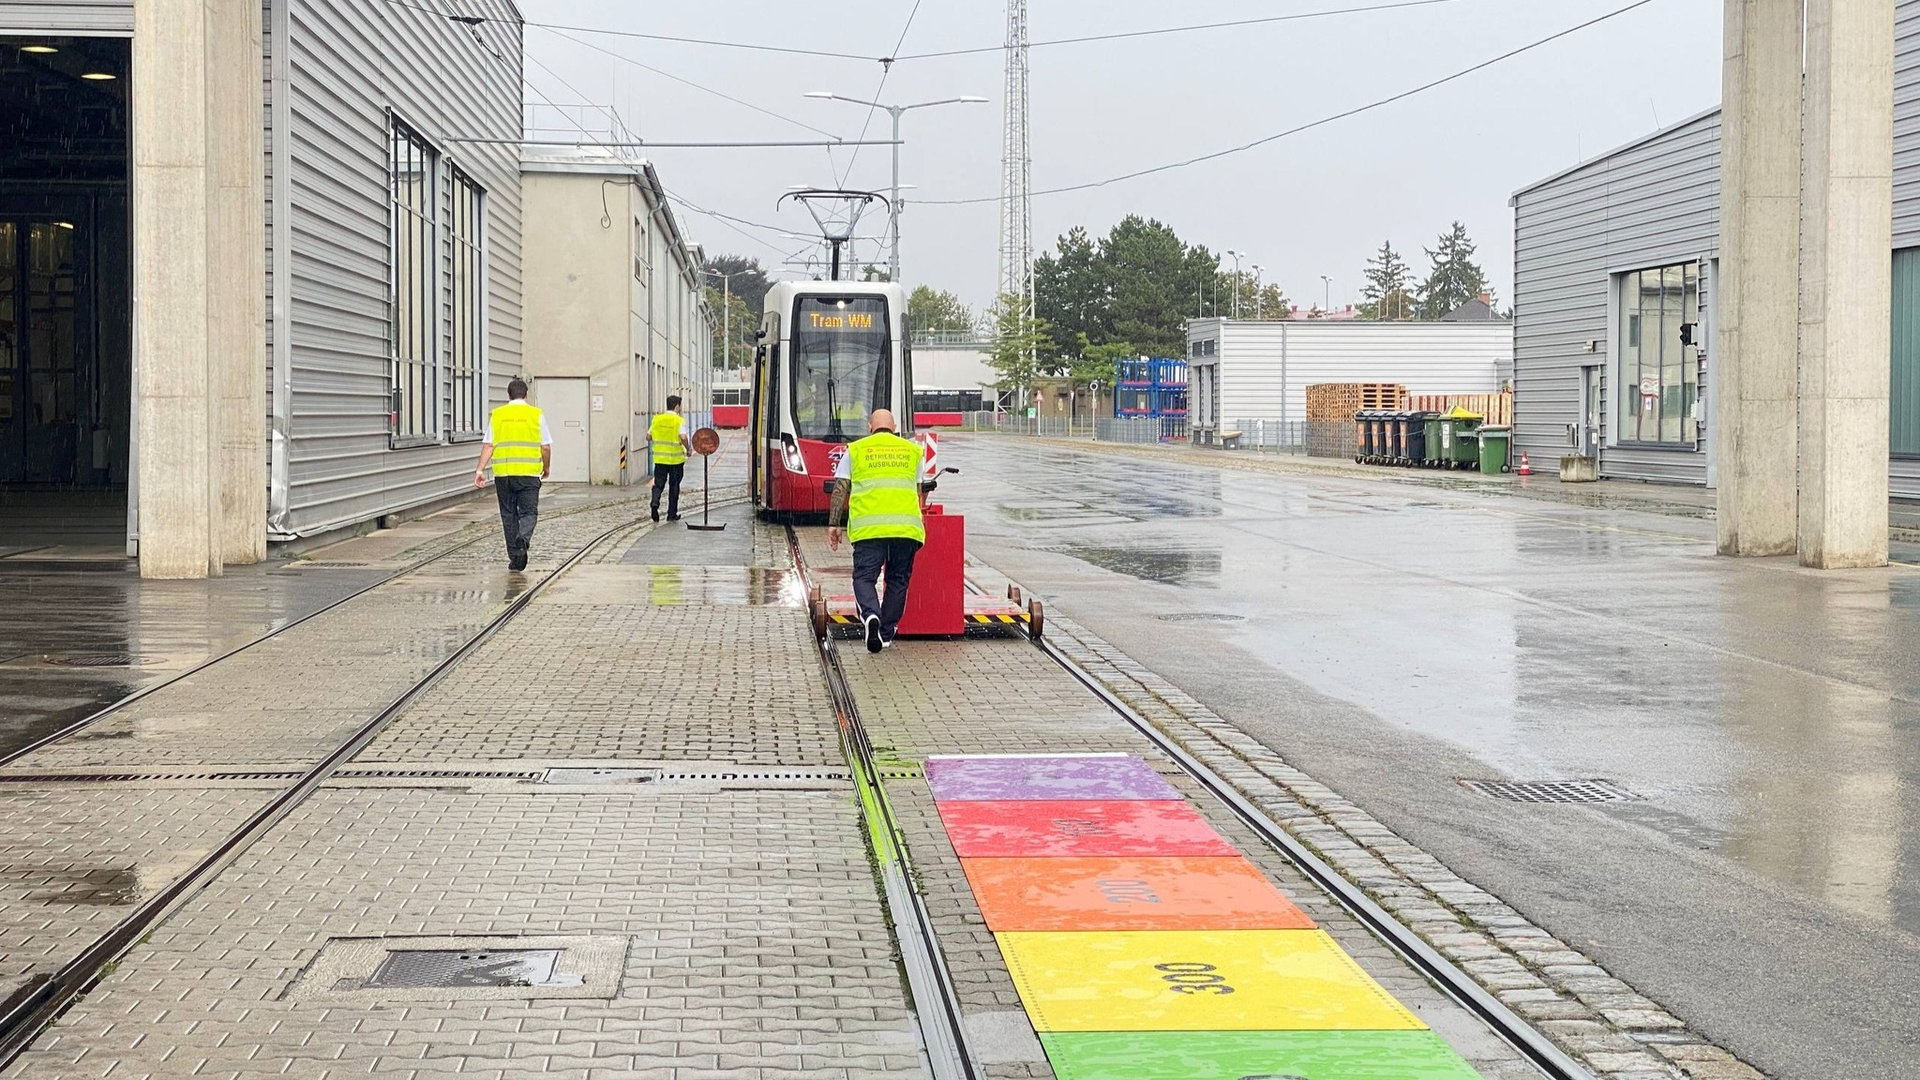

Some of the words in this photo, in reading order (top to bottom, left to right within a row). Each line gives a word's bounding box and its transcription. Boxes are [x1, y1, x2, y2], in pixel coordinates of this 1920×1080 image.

[810, 313, 843, 328] Tram
[848, 313, 872, 328] WM
[868, 460, 909, 469] AUSBILDUNG
[1096, 879, 1162, 904] 200
[1154, 962, 1235, 995] 300
